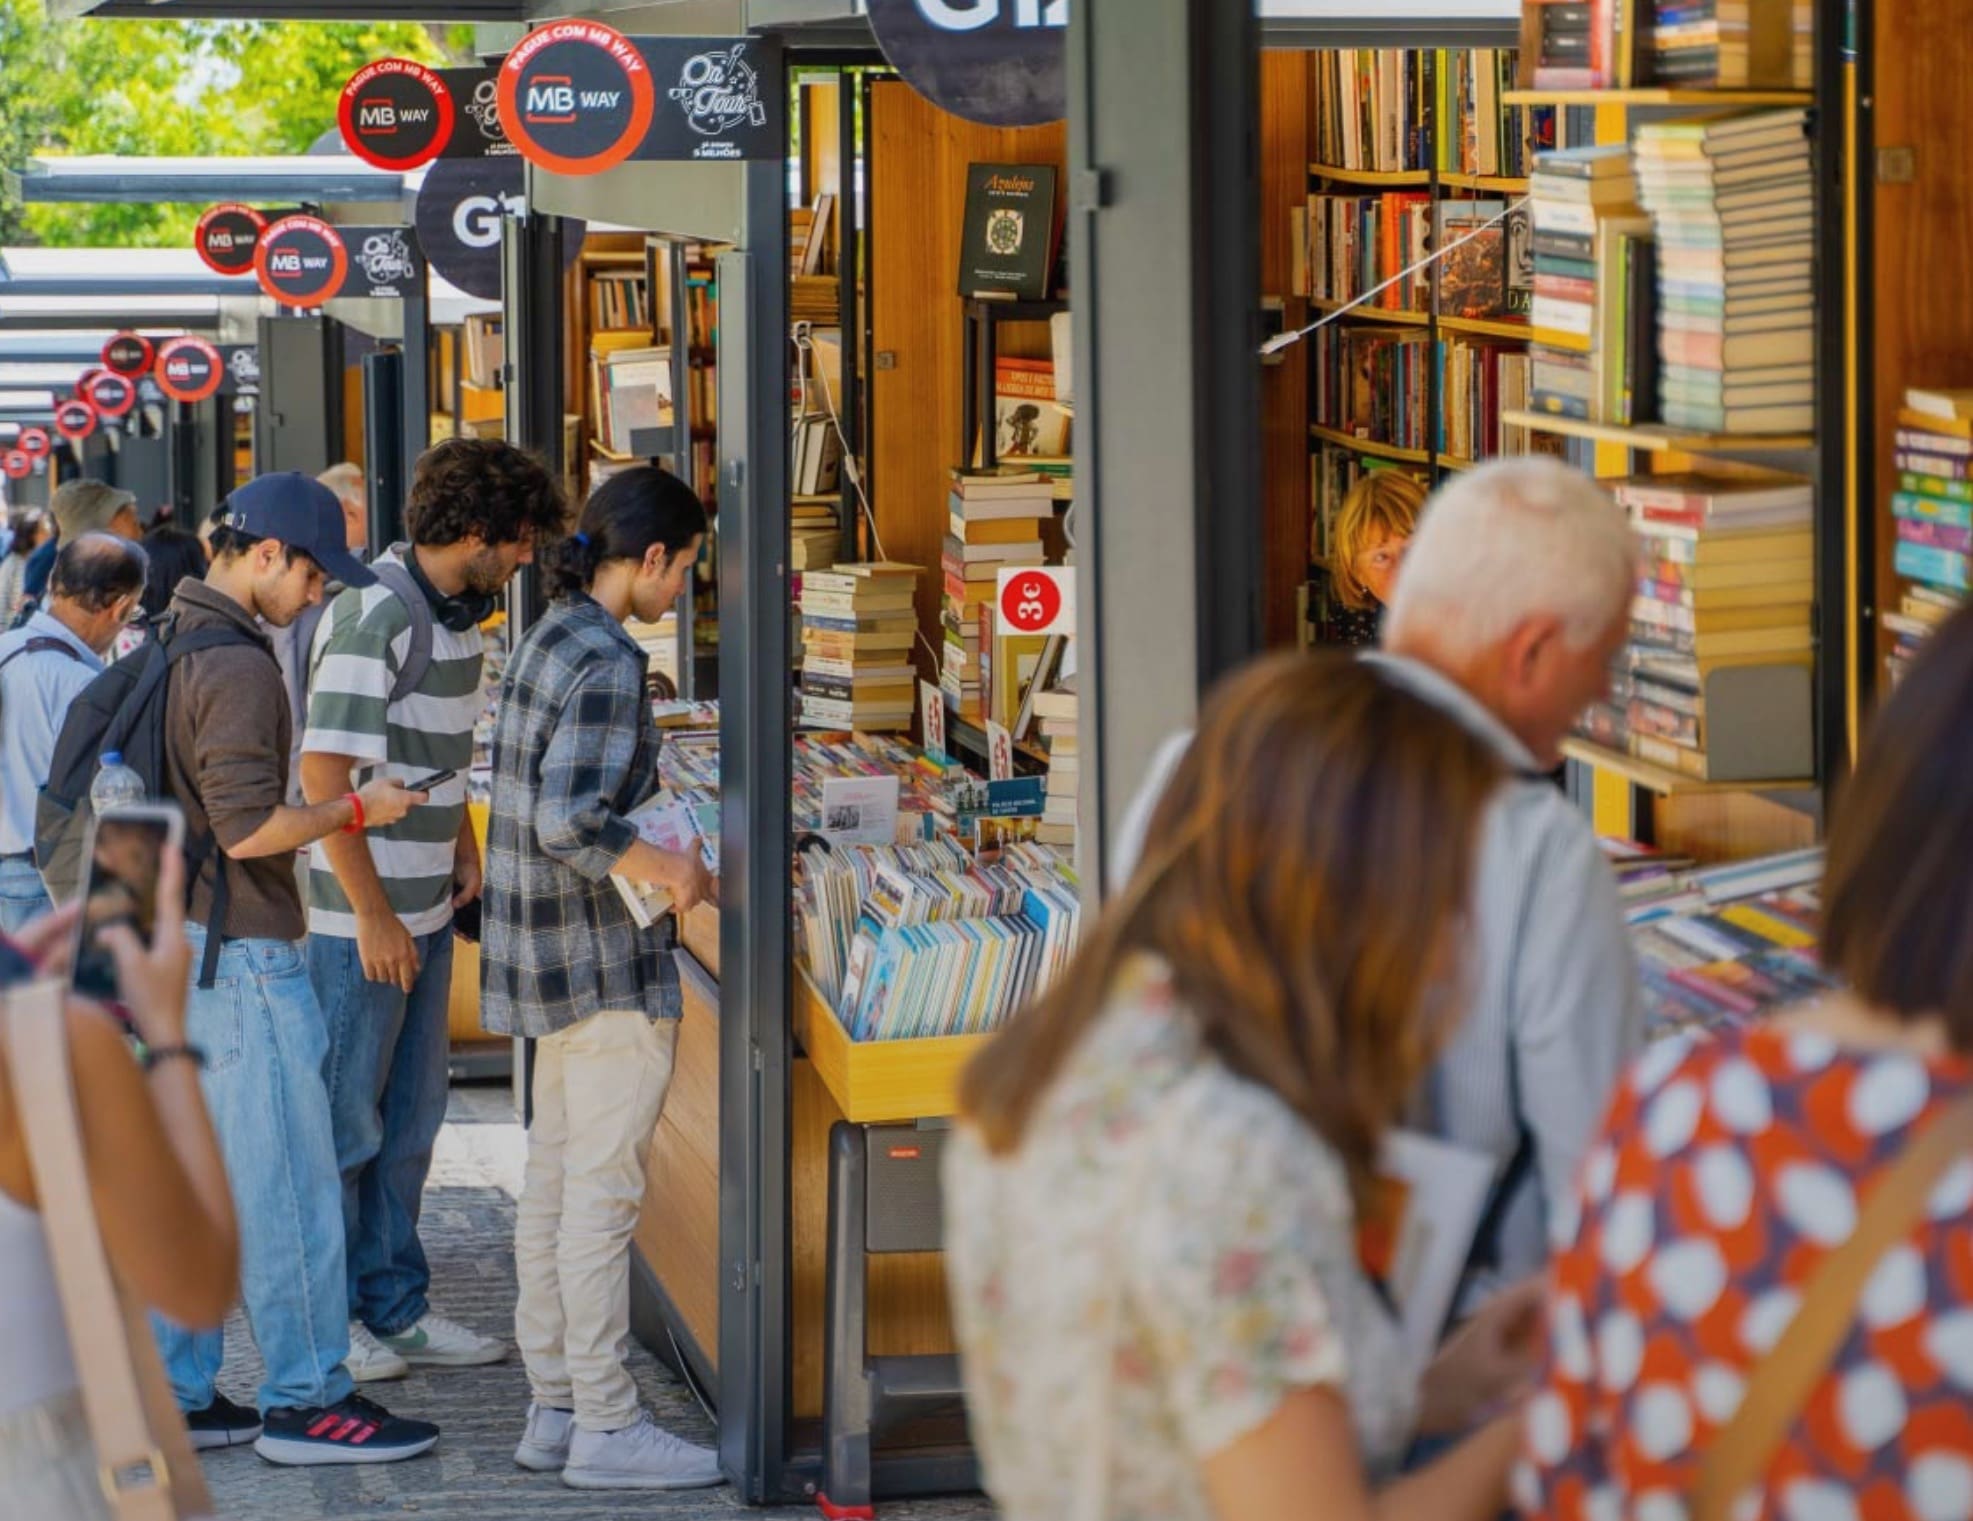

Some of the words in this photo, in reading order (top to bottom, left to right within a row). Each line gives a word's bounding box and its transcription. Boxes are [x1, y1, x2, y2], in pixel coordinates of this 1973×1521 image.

[508, 30, 550, 71] PAGUE
[552, 25, 586, 39] COM
[588, 29, 611, 46] MB
[611, 40, 643, 72] WAY
[345, 65, 377, 97] PAGUE
[377, 62, 402, 73] COM
[404, 63, 421, 76] MB
[421, 71, 446, 95] WAY
[526, 86, 575, 112] MB
[580, 91, 621, 108] WAY
[360, 107, 396, 126] MB
[400, 109, 429, 122] WAY
[271, 255, 301, 271] MB
[302, 257, 328, 269] WAY
